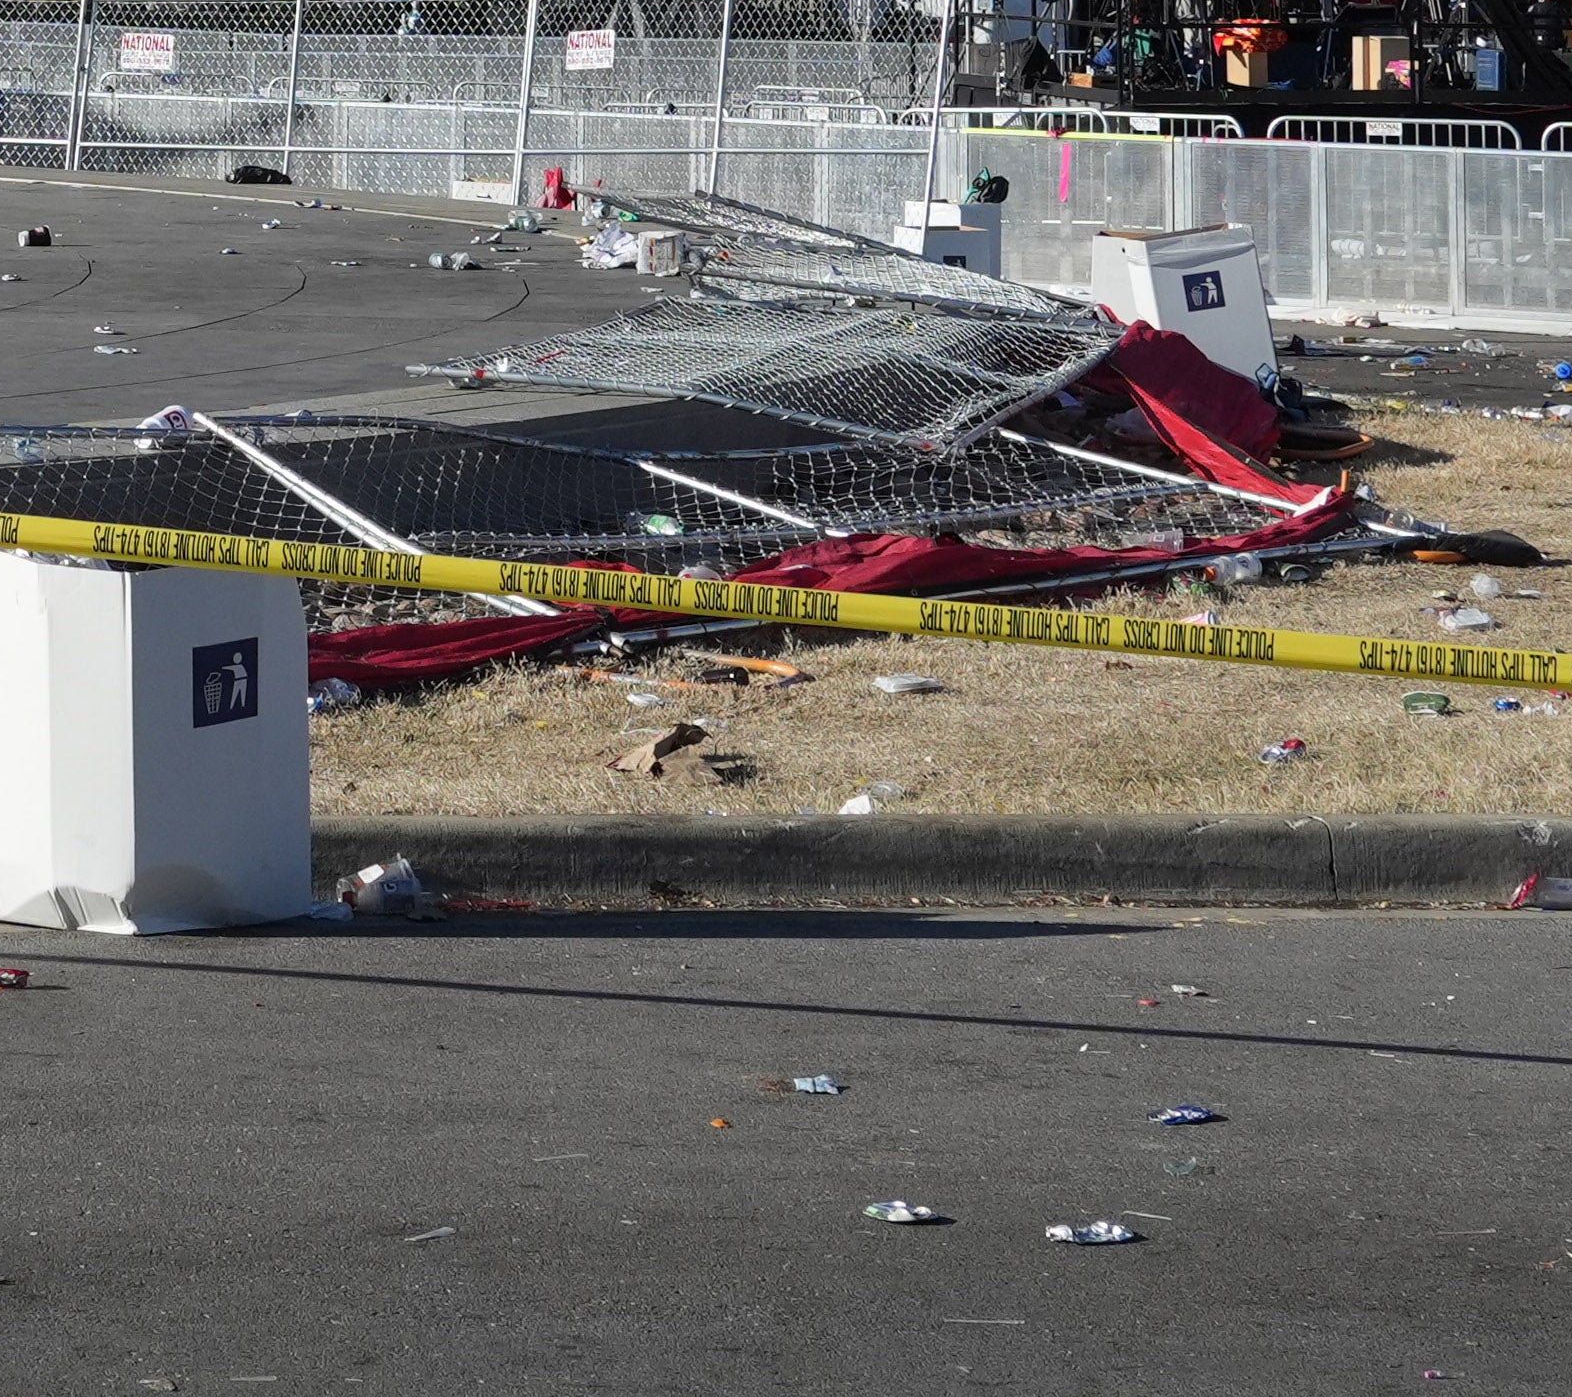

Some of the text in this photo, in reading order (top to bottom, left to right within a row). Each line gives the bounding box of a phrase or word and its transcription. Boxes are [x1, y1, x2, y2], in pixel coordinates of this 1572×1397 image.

[123, 35, 171, 51] NATIONAL
[568, 32, 611, 50] NATIONAL
[93, 525, 422, 583] POLICE LINE DO NOT CROSS CALL TIPS HOTLINE (816) 474-TIPS
[920, 601, 1274, 660] POLICE LINE DO NOT CROSS CALL TIPS HOTLINE (816) 474-TIPS
